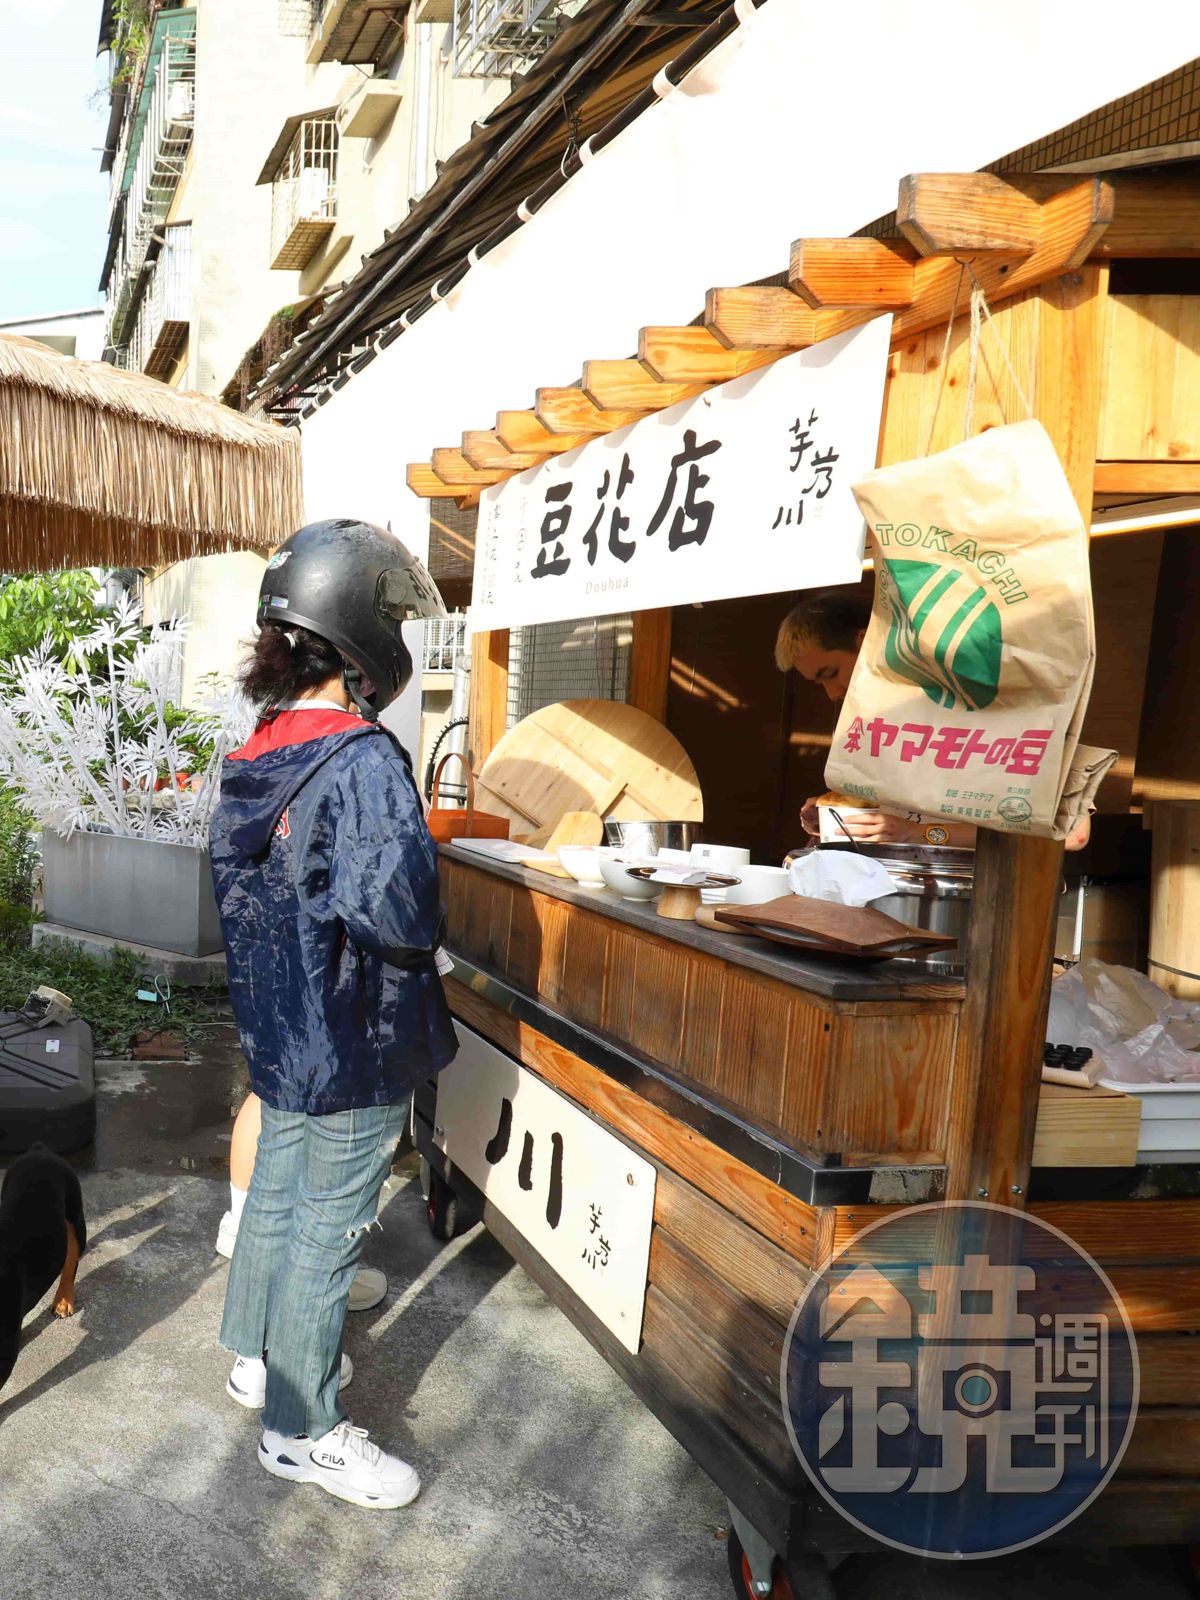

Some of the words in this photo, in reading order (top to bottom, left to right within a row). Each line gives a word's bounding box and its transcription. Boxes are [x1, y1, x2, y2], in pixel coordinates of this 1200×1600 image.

[531, 429, 722, 579] 豆花店
[585, 577, 629, 594] Douhua
[876, 523, 1029, 605] TOKACHI
[866, 717, 1054, 776] ヤマモトの豆
[321, 1452, 345, 1466] FILA
